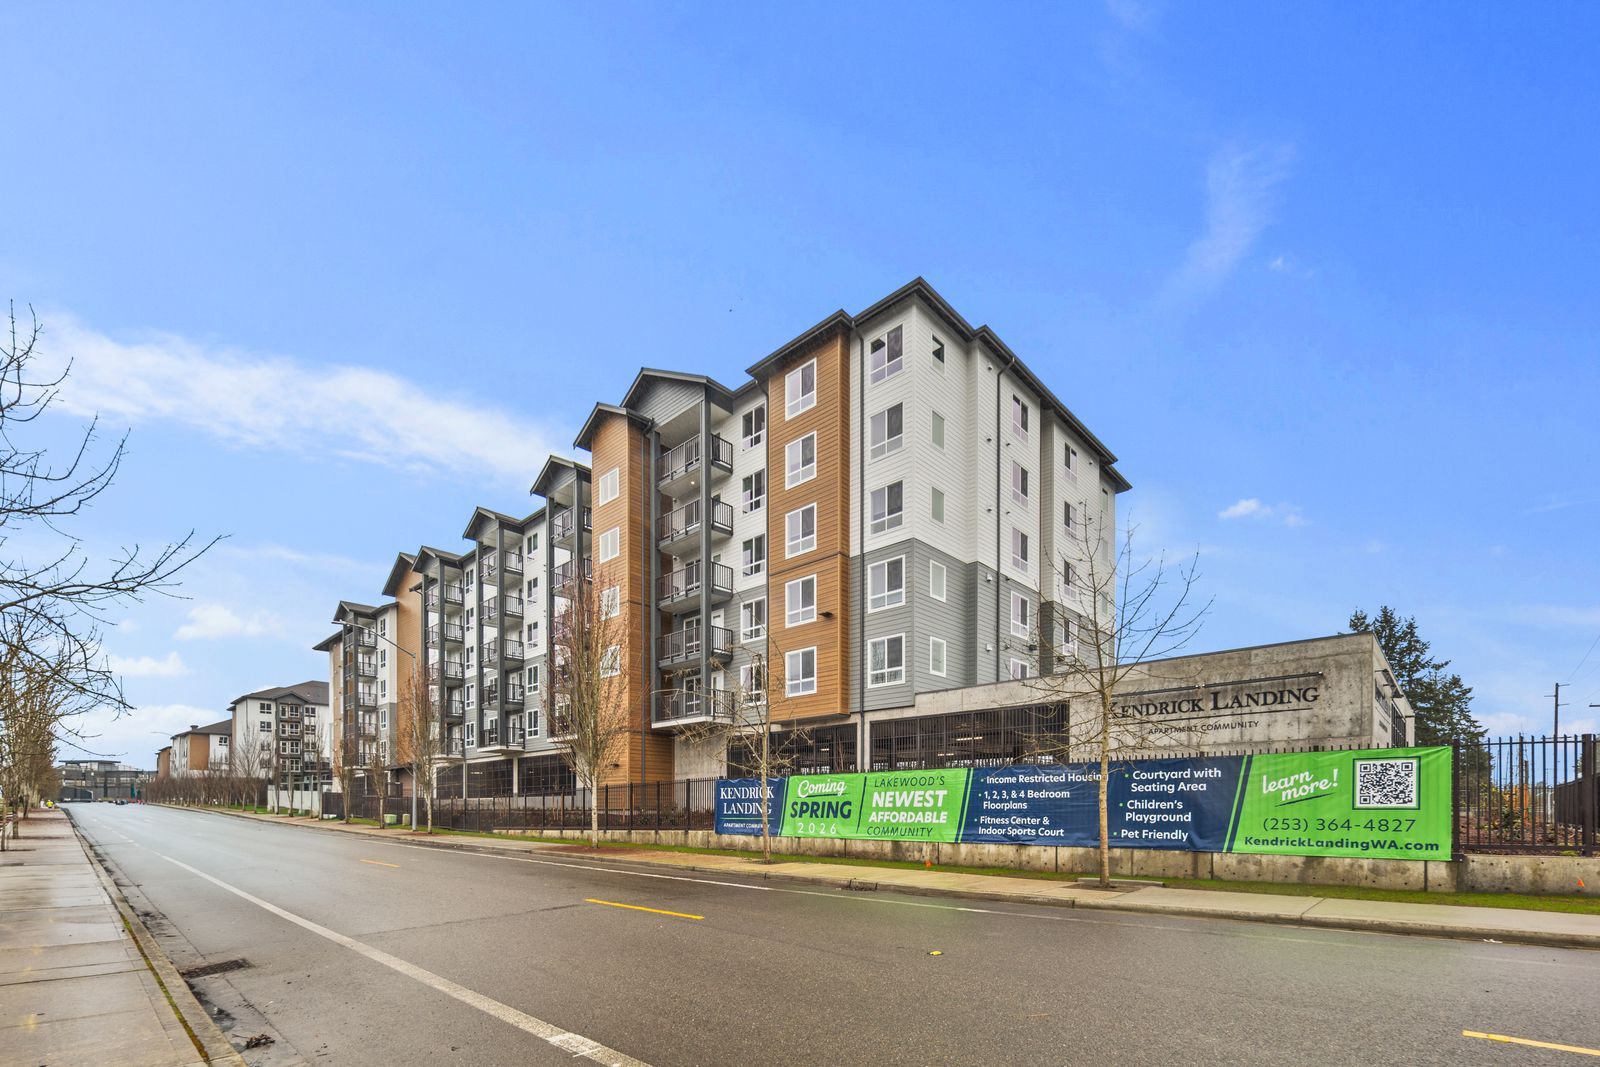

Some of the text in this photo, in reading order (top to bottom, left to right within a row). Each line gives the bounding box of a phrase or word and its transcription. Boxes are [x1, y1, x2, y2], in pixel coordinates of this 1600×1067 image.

[1210, 686, 1321, 711] LANDING
[1148, 720, 1259, 735] APARTMENT COMMUNITY
[986, 772, 1108, 784] Income Restricted Housin
[1132, 767, 1222, 781] Courtyard with
[798, 778, 847, 798] Coming
[874, 775, 945, 788] LAKEWOOD'S
[1130, 781, 1207, 794] Seating Area
[1262, 770, 1313, 794] learn
[1281, 768, 1339, 801] more!
[872, 789, 948, 808] NEWEST
[984, 789, 1070, 800] 1, 2, 3, & 4 Bedroom
[790, 800, 852, 819] SPRING
[983, 800, 1028, 811] Floorplans
[1126, 799, 1183, 810] Children's
[868, 811, 948, 824] AFFORDABLE
[980, 815, 1050, 825] Fitness Center &
[1125, 811, 1192, 824] Playground
[797, 822, 837, 835] 2026
[866, 826, 933, 837] COMMUNITY
[978, 826, 1065, 837] Indoor Sports Court
[1262, 817, 1416, 833] (253) 364-4827
[1120, 829, 1189, 842] Pet Friendly
[1244, 836, 1440, 851] KendrickLandingWA.com
